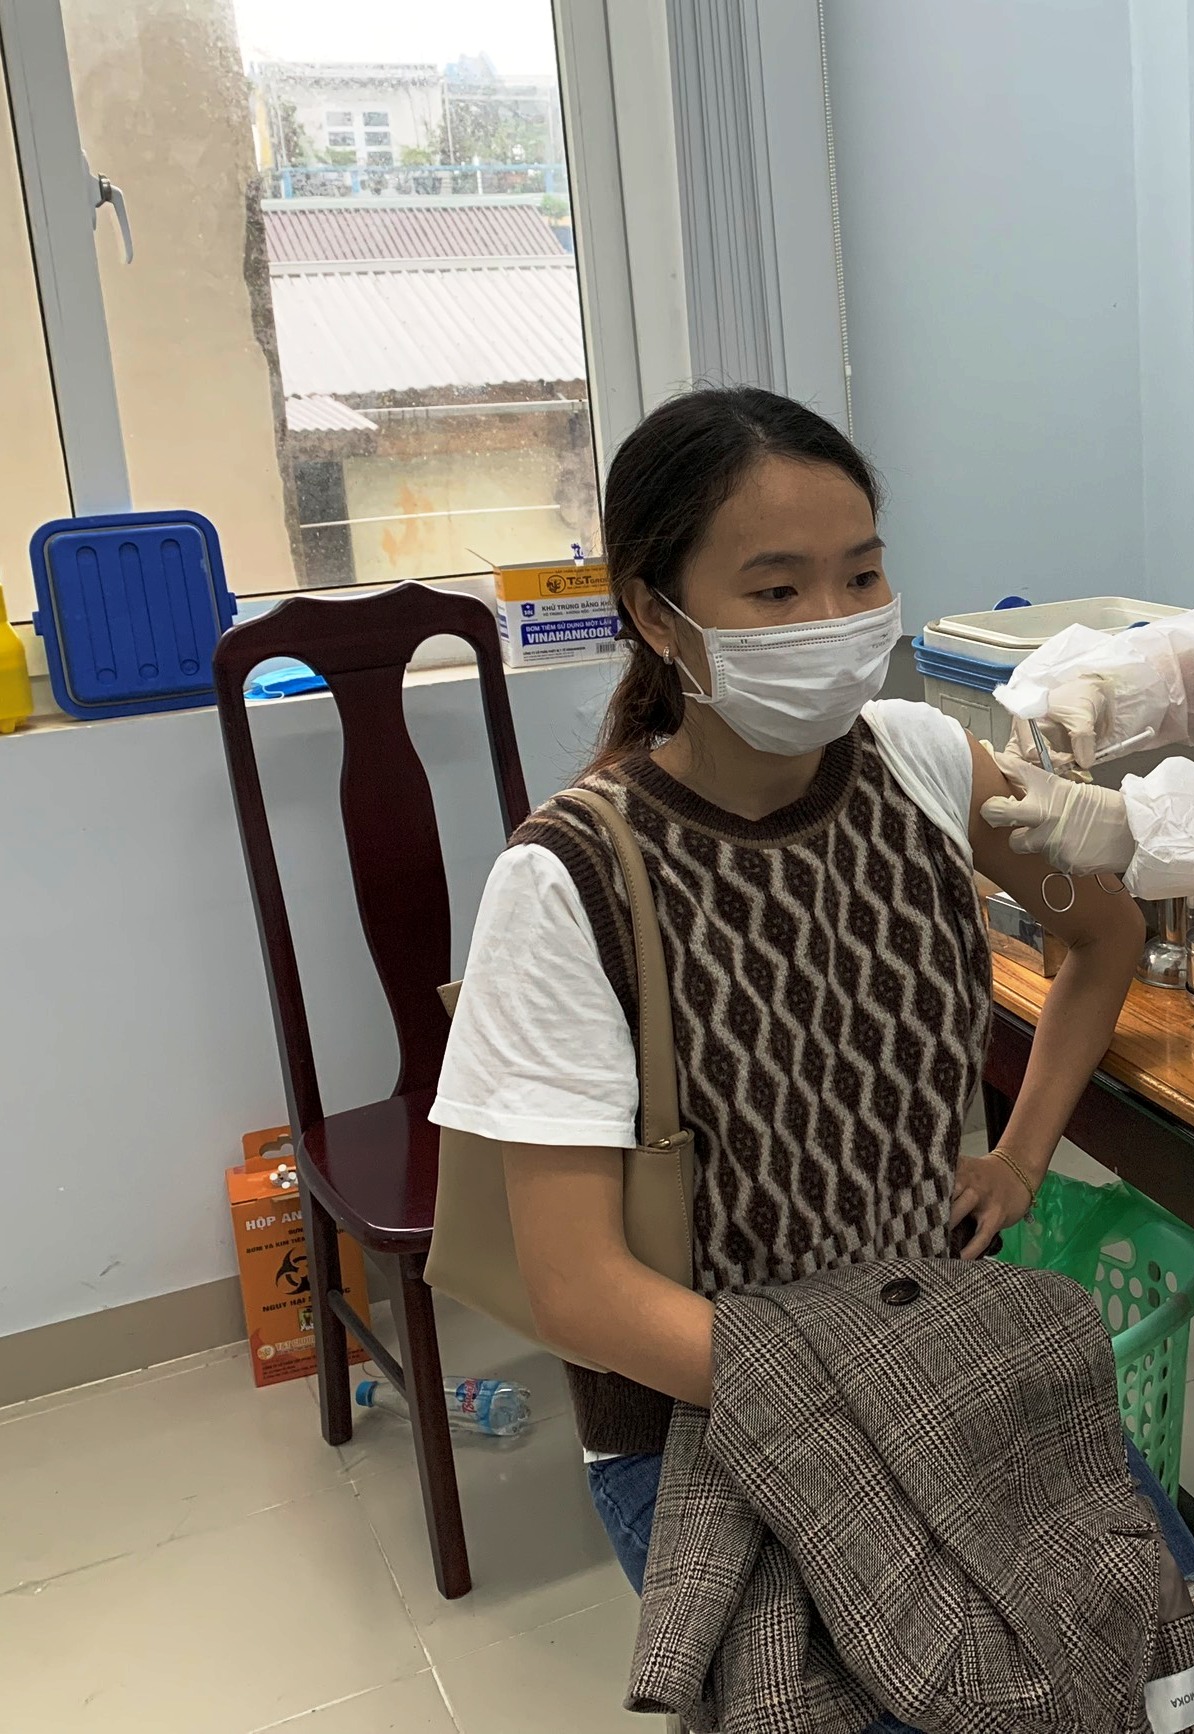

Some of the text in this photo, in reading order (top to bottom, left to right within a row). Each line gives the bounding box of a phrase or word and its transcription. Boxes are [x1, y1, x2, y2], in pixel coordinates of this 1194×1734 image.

[566, 575, 592, 586] T&T
[527, 626, 613, 644] VINAHANKOOK
[246, 1210, 302, 1230] HỘP AN
[262, 1301, 288, 1312] NGUY
